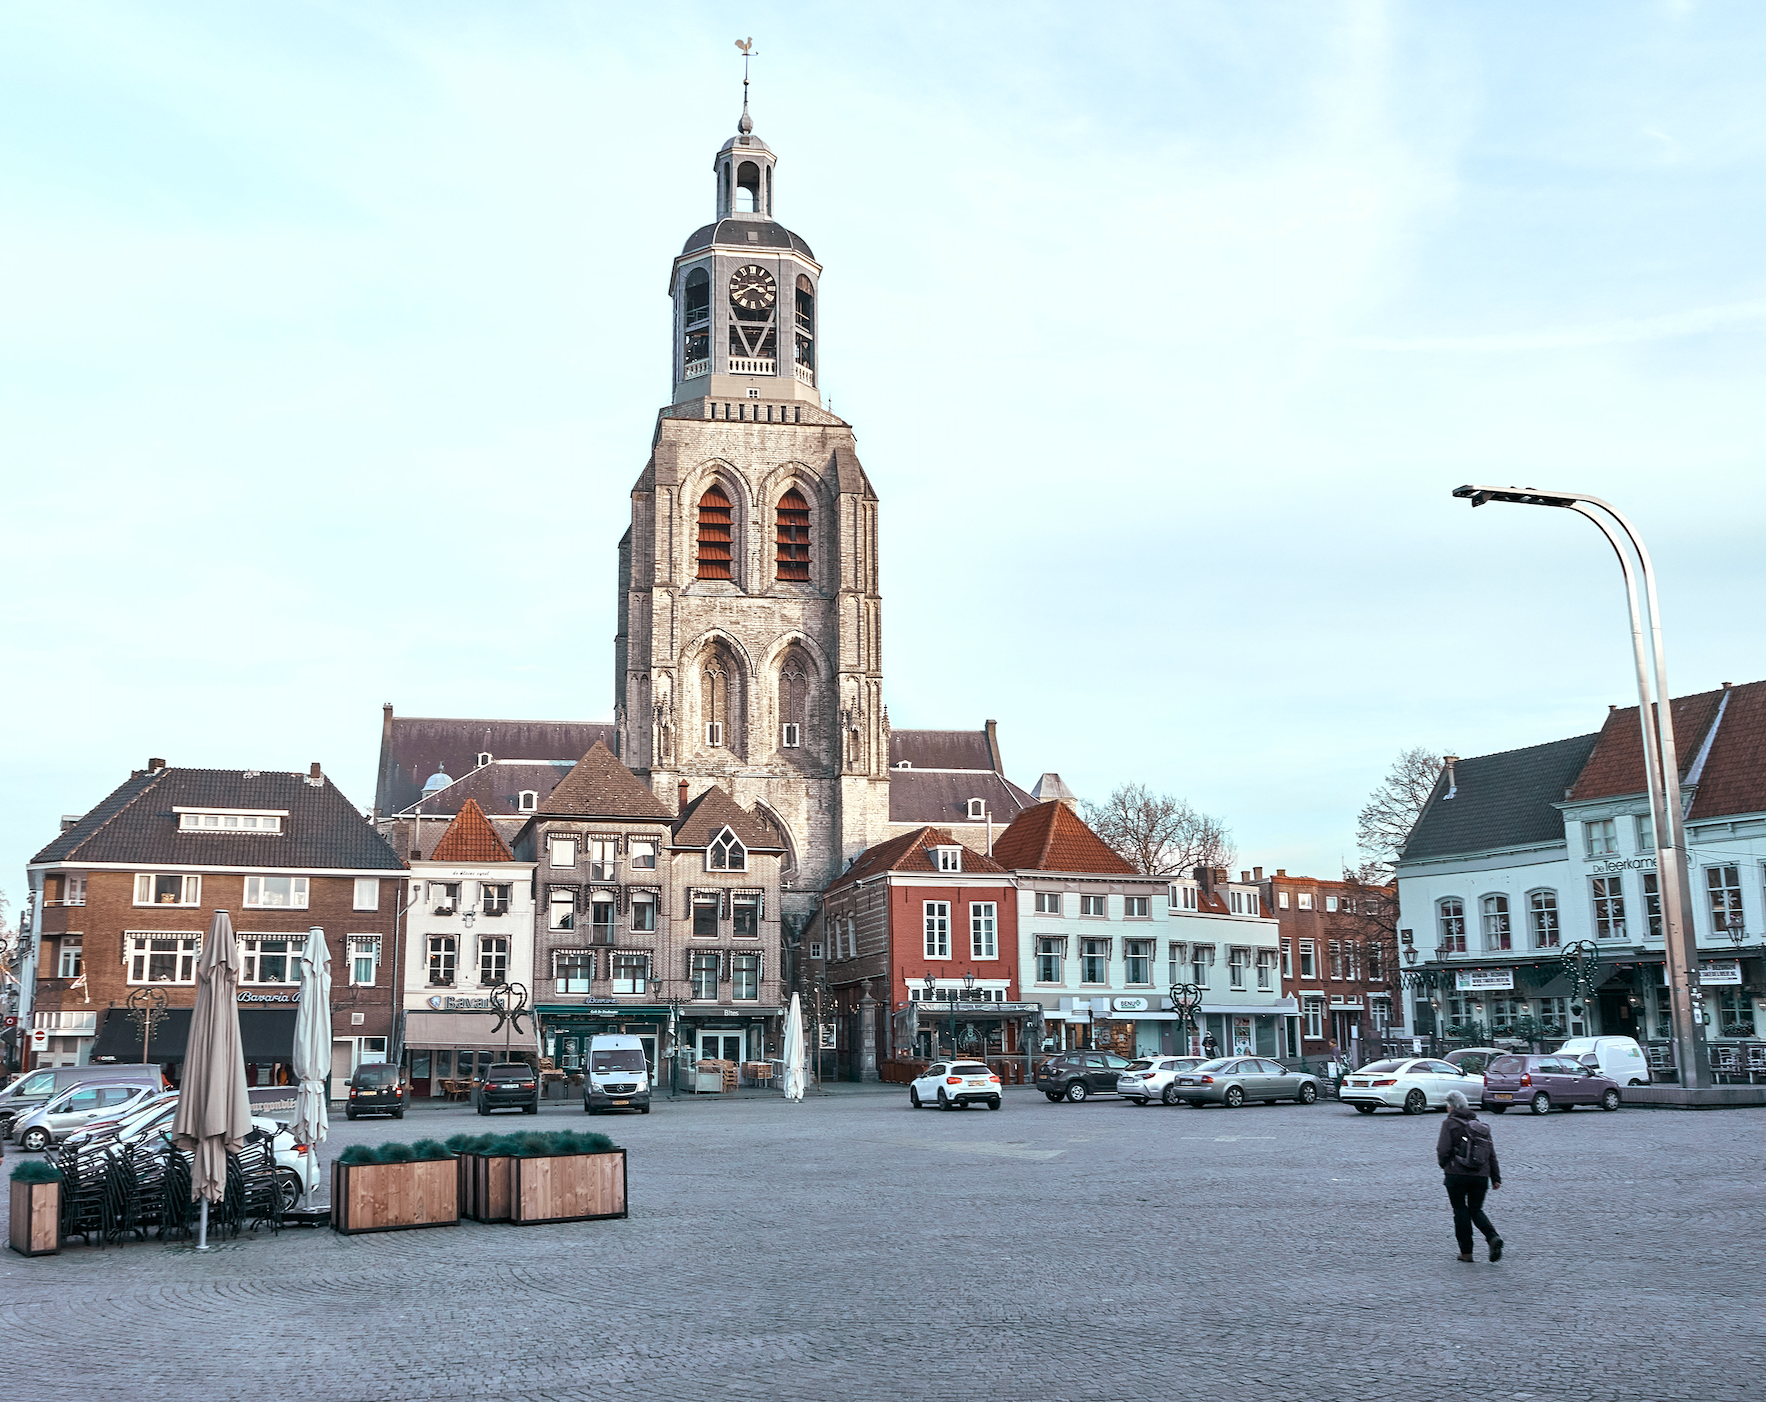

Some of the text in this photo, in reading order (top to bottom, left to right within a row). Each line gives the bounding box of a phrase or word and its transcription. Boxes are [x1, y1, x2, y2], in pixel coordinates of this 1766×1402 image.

[1593, 858, 1657, 873] De Teerkame
[237, 991, 289, 1002] Bavaria
